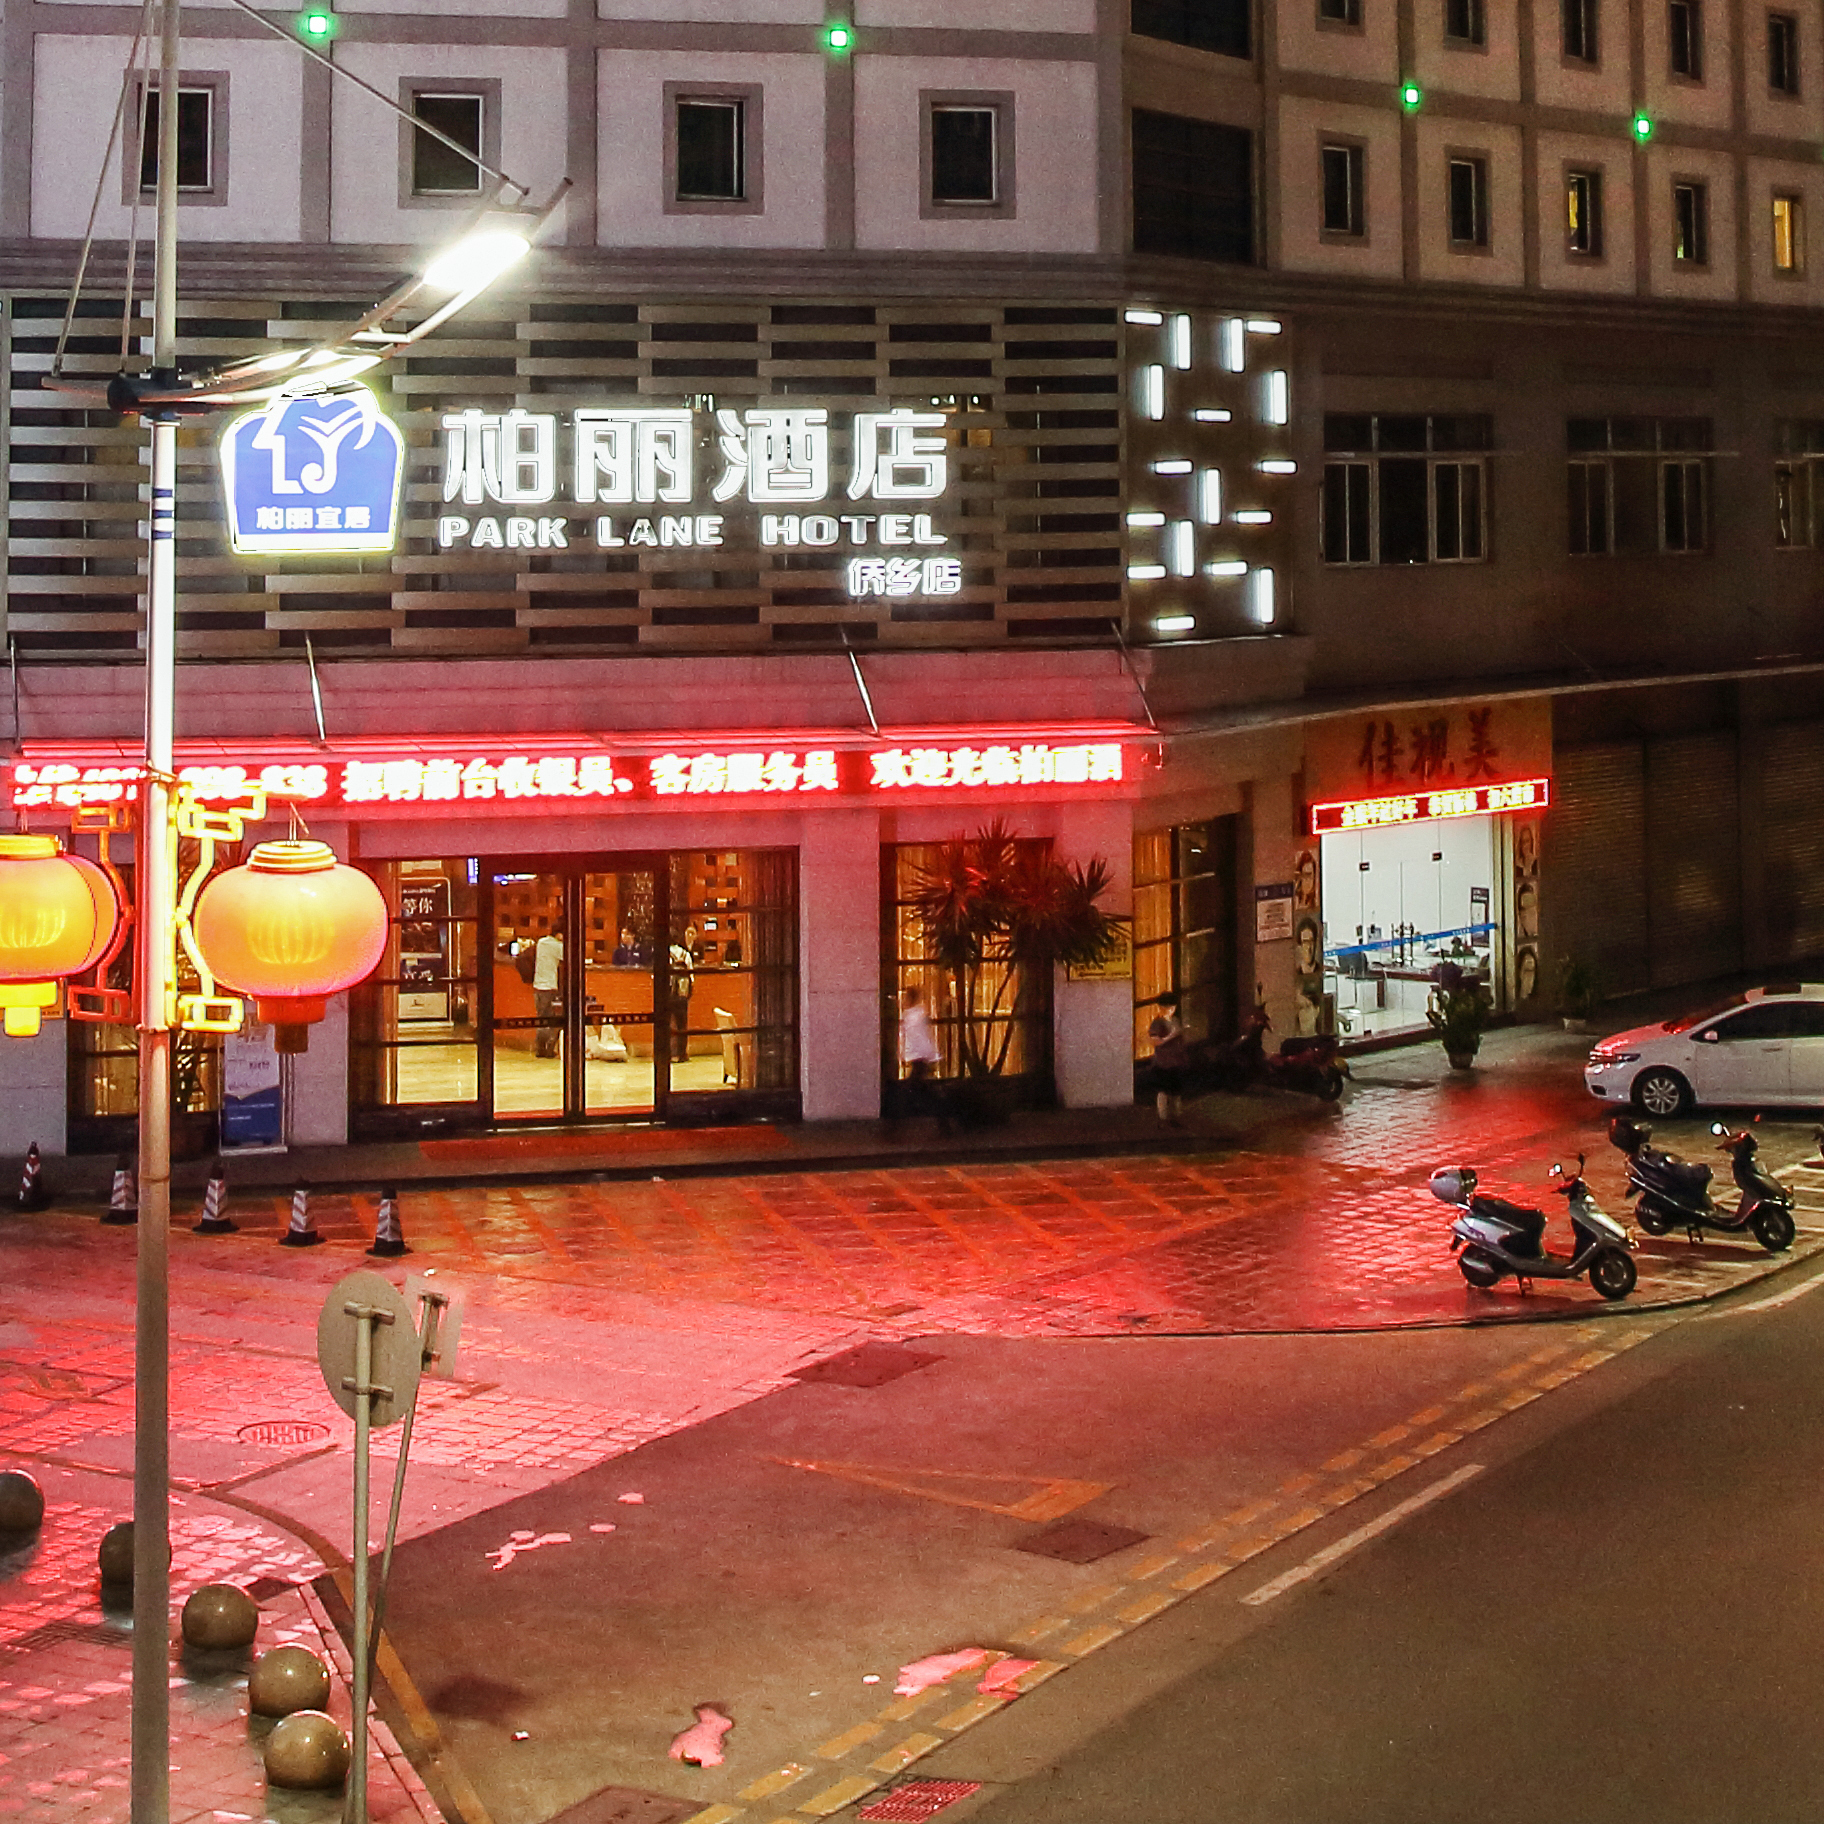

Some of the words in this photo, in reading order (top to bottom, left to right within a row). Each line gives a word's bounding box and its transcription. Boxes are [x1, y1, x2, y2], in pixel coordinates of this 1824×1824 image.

[442, 407, 948, 505] 柏丽酒店
[256, 505, 372, 530] 柏丽宜居
[439, 516, 569, 549] PARK
[596, 515, 725, 547] LANE
[761, 514, 949, 546] HOTEL
[847, 556, 963, 597] 侨乡店
